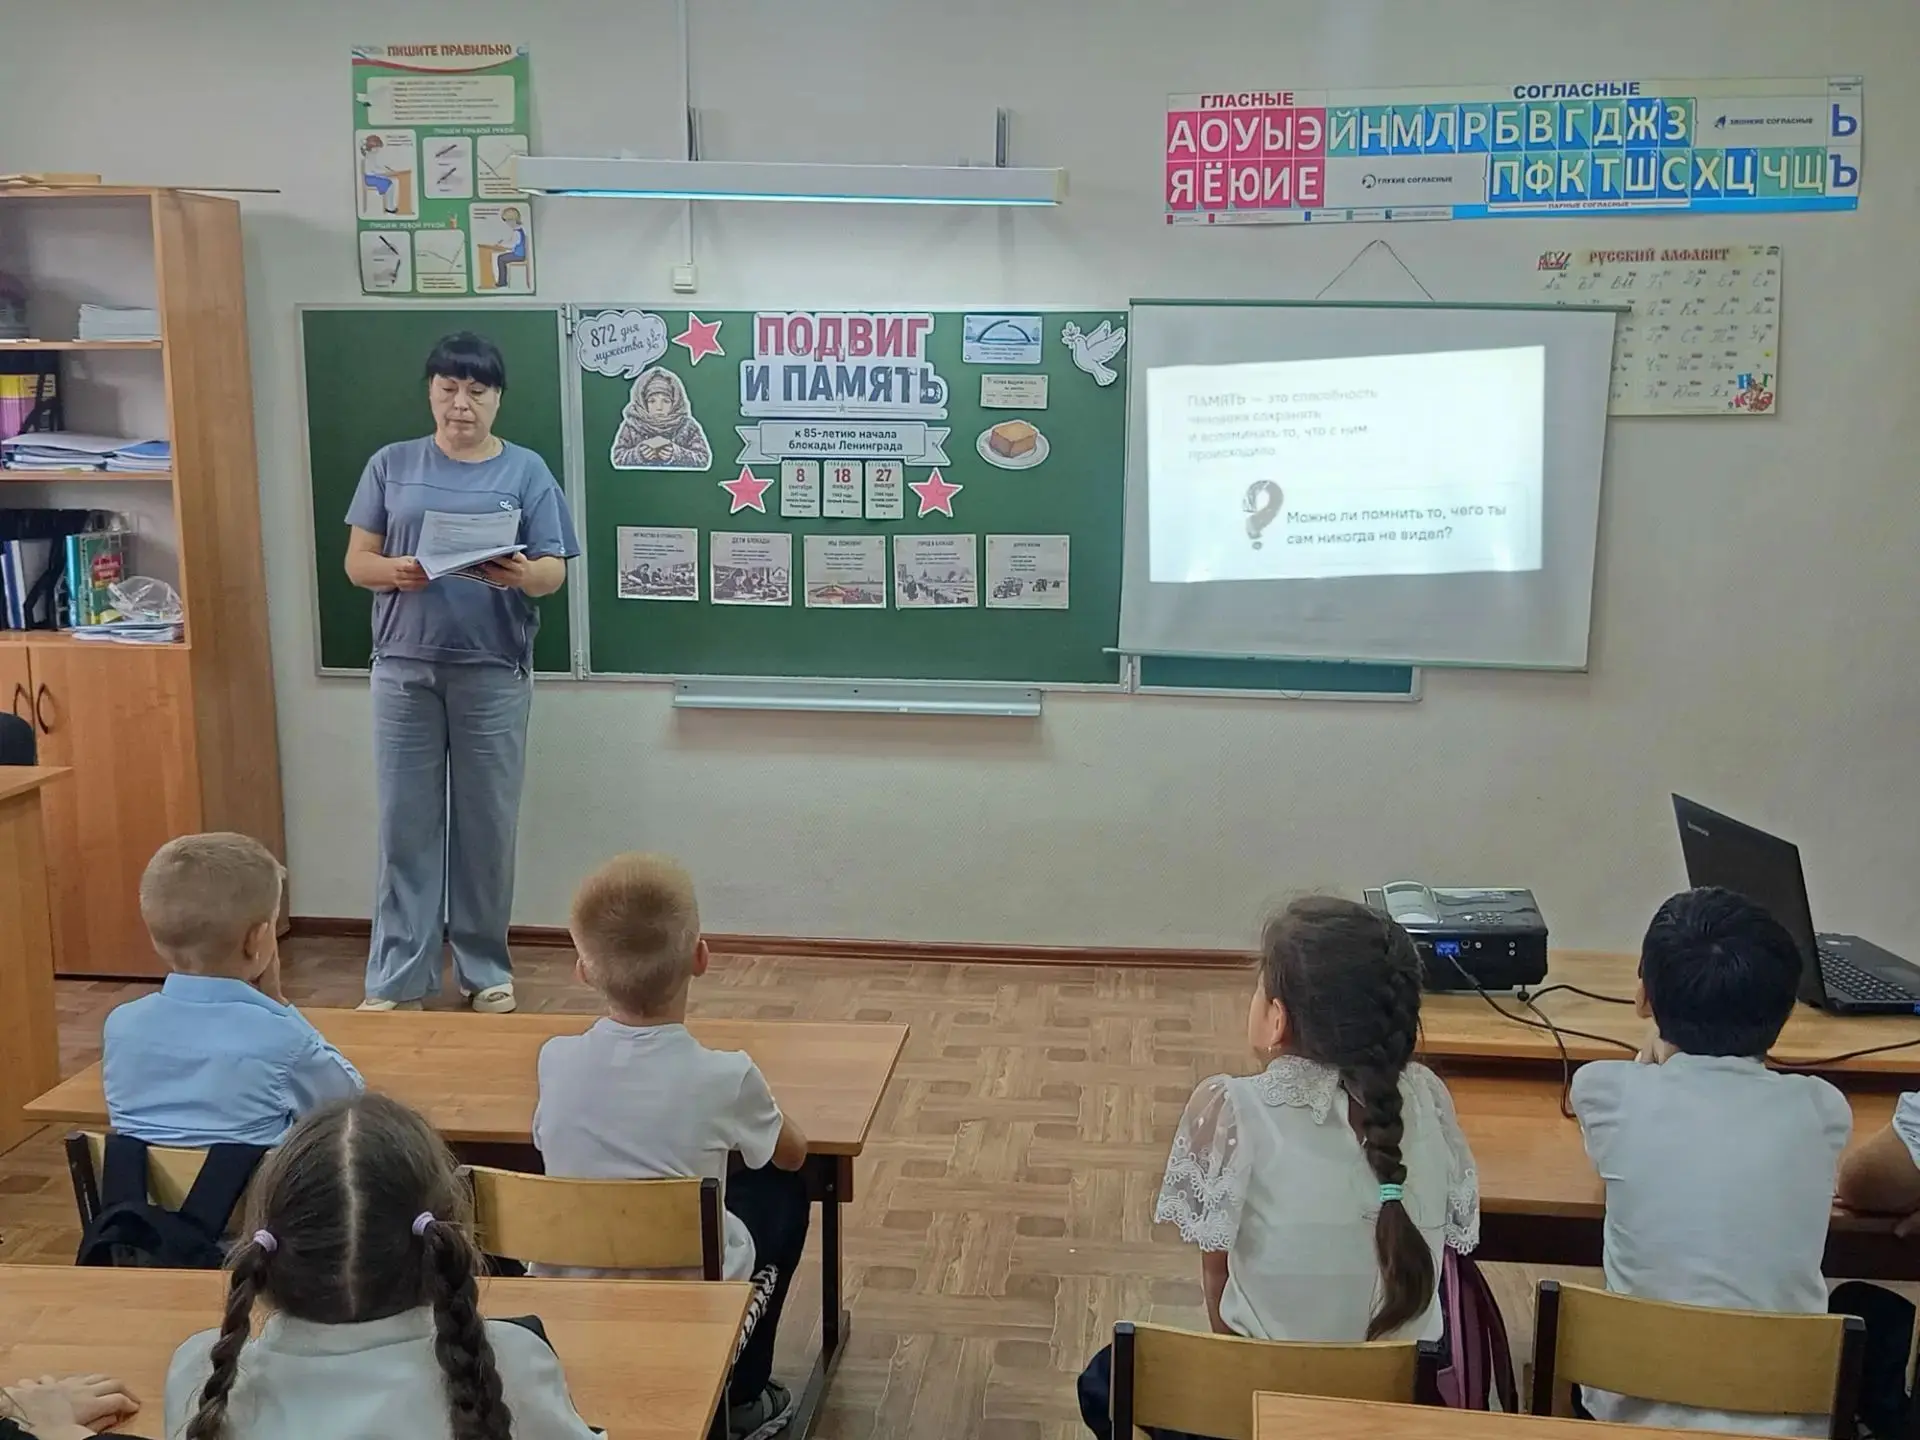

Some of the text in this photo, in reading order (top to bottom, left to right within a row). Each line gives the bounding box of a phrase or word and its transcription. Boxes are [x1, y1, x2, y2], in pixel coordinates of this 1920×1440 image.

[387, 45, 439, 56] ПИШИТЕ
[441, 44, 512, 56] ПРАВИЛЬНО
[1513, 81, 1641, 99] СОГЛАСНЫЕ
[1201, 92, 1294, 109] ГЛАСНЫЕ
[1590, 248, 1730, 265] РУССКИЙ АЛФАВИТ
[590, 323, 640, 348] 872 дня
[758, 316, 929, 362] ПОДВИГ
[593, 336, 645, 365] мужества
[746, 365, 944, 403] И ПАМЯТЬ
[1188, 393, 1246, 407] ПАМЯТЬ
[1268, 394, 1289, 403] это
[1292, 388, 1379, 402] способность
[795, 428, 897, 439] к 85-летию начала
[1304, 427, 1326, 437] что
[1329, 427, 1337, 435] с
[1341, 425, 1368, 435] ним
[788, 440, 903, 452] блокады Ленинграда
[796, 468, 805, 482] 8
[834, 468, 851, 483] 18
[876, 469, 892, 482] 27
[1287, 505, 1507, 524] Можно ли помнить то, чего ты
[1287, 526, 1453, 544] сам никогда не видел?
